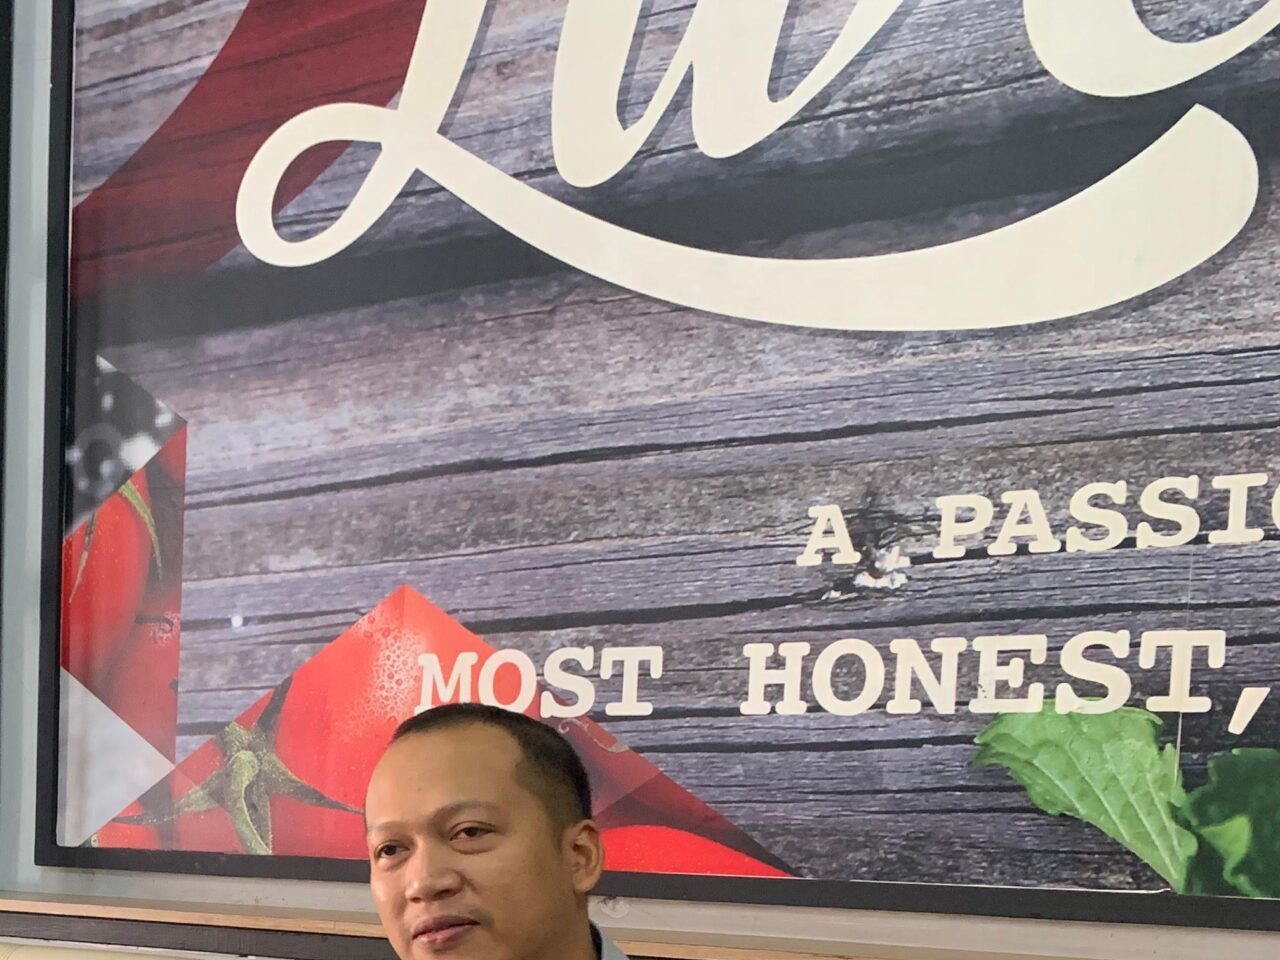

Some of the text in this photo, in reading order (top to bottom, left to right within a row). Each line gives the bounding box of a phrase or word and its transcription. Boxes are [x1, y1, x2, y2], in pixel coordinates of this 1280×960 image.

[796, 472, 1280, 567] A PASSI
[413, 629, 1271, 736] MOST HONEST,
